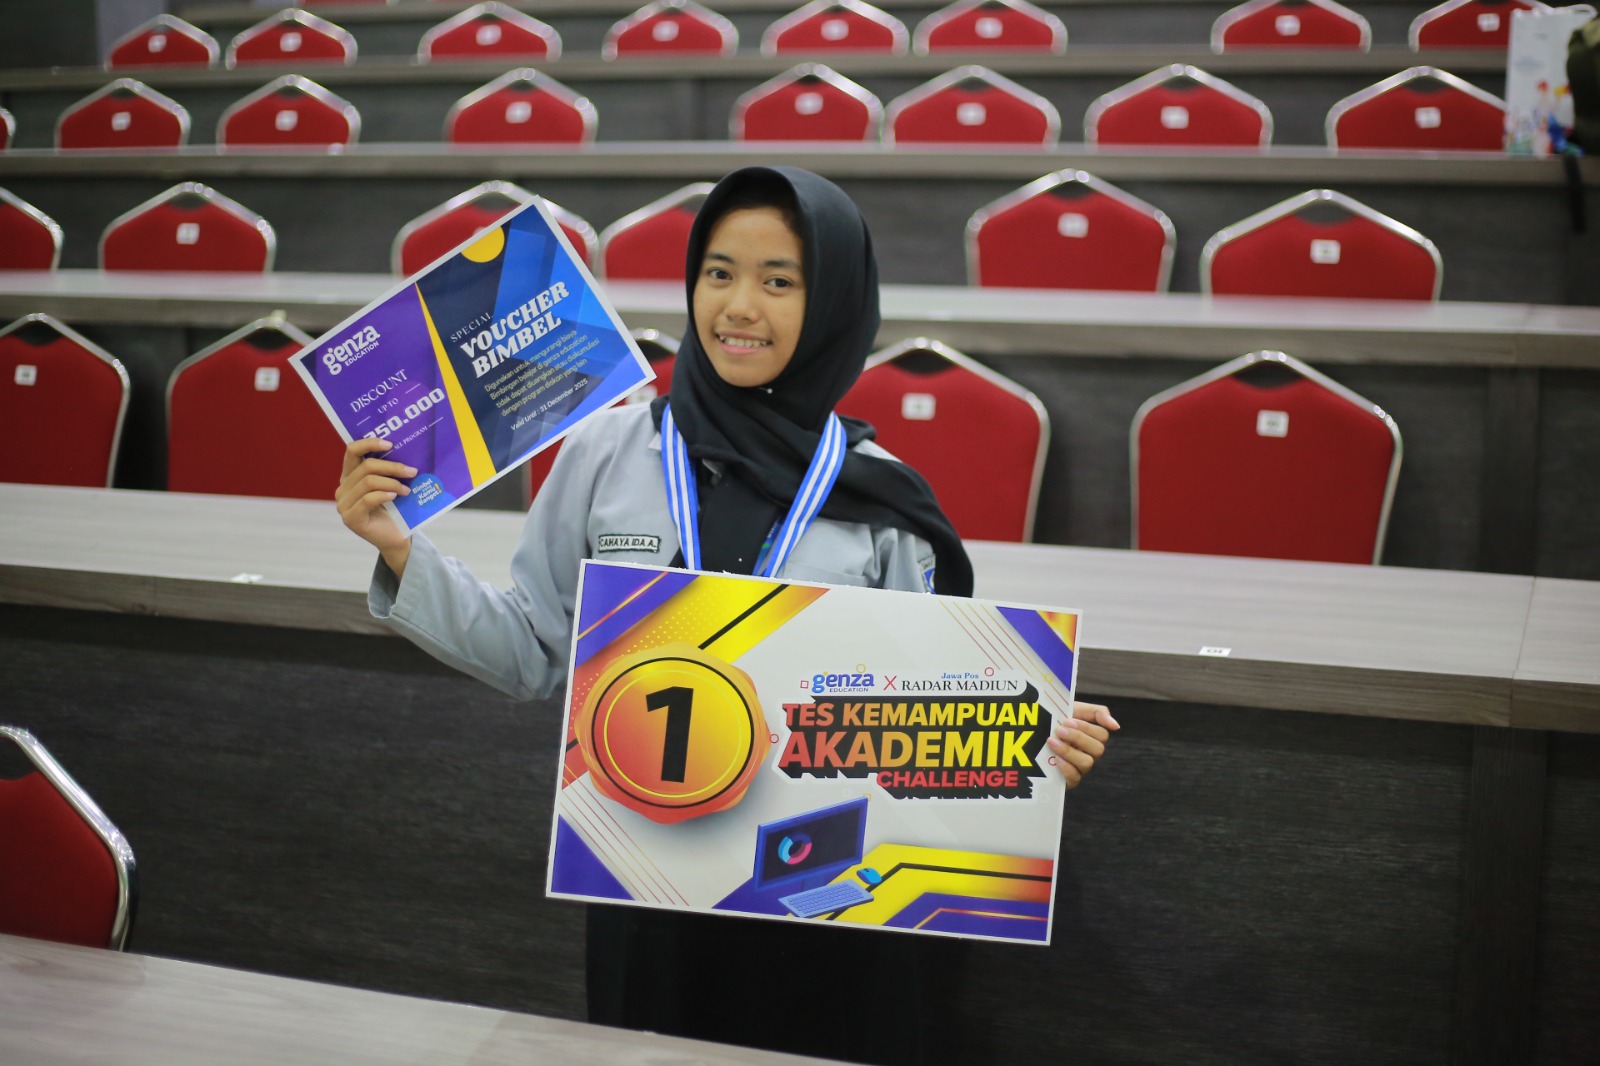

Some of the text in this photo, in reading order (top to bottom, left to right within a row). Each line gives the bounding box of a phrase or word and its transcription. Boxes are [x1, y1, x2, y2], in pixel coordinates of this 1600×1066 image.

[451, 312, 494, 342] SPECIAL
[460, 282, 569, 358] VOUCHER
[322, 325, 381, 375] genza
[345, 341, 379, 366] EDUCATION
[472, 312, 562, 378] BIMBEL
[484, 330, 576, 391] Digunakan untuk mengurangi biaya
[490, 378, 518, 399] Bimbingan
[518, 366, 536, 380] belajar
[543, 351, 560, 365] genza
[560, 334, 587, 354] education
[496, 394, 510, 407] tidak
[509, 385, 526, 398] dapat
[525, 367, 554, 387] diuangkan
[554, 358, 567, 370] atau
[501, 357, 587, 415] dengan program diskon yang lain
[350, 369, 408, 412] DISCOUNT
[378, 397, 398, 413] UP TO
[511, 418, 524, 430] Valid
[524, 410, 537, 421] Until
[539, 404, 546, 412] 31
[547, 387, 573, 407] December
[403, 426, 427, 443] PROGRAM
[600, 538, 656, 548] CAHAYA IDA A.
[812, 671, 874, 693] genza
[902, 680, 1018, 691] RADAR MADIUN
[782, 702, 1039, 726] TES KEMAMPUAN
[645, 686, 694, 783] 1
[779, 730, 1035, 767] AKADEMIK
[876, 771, 1018, 787] CHALLENGE
